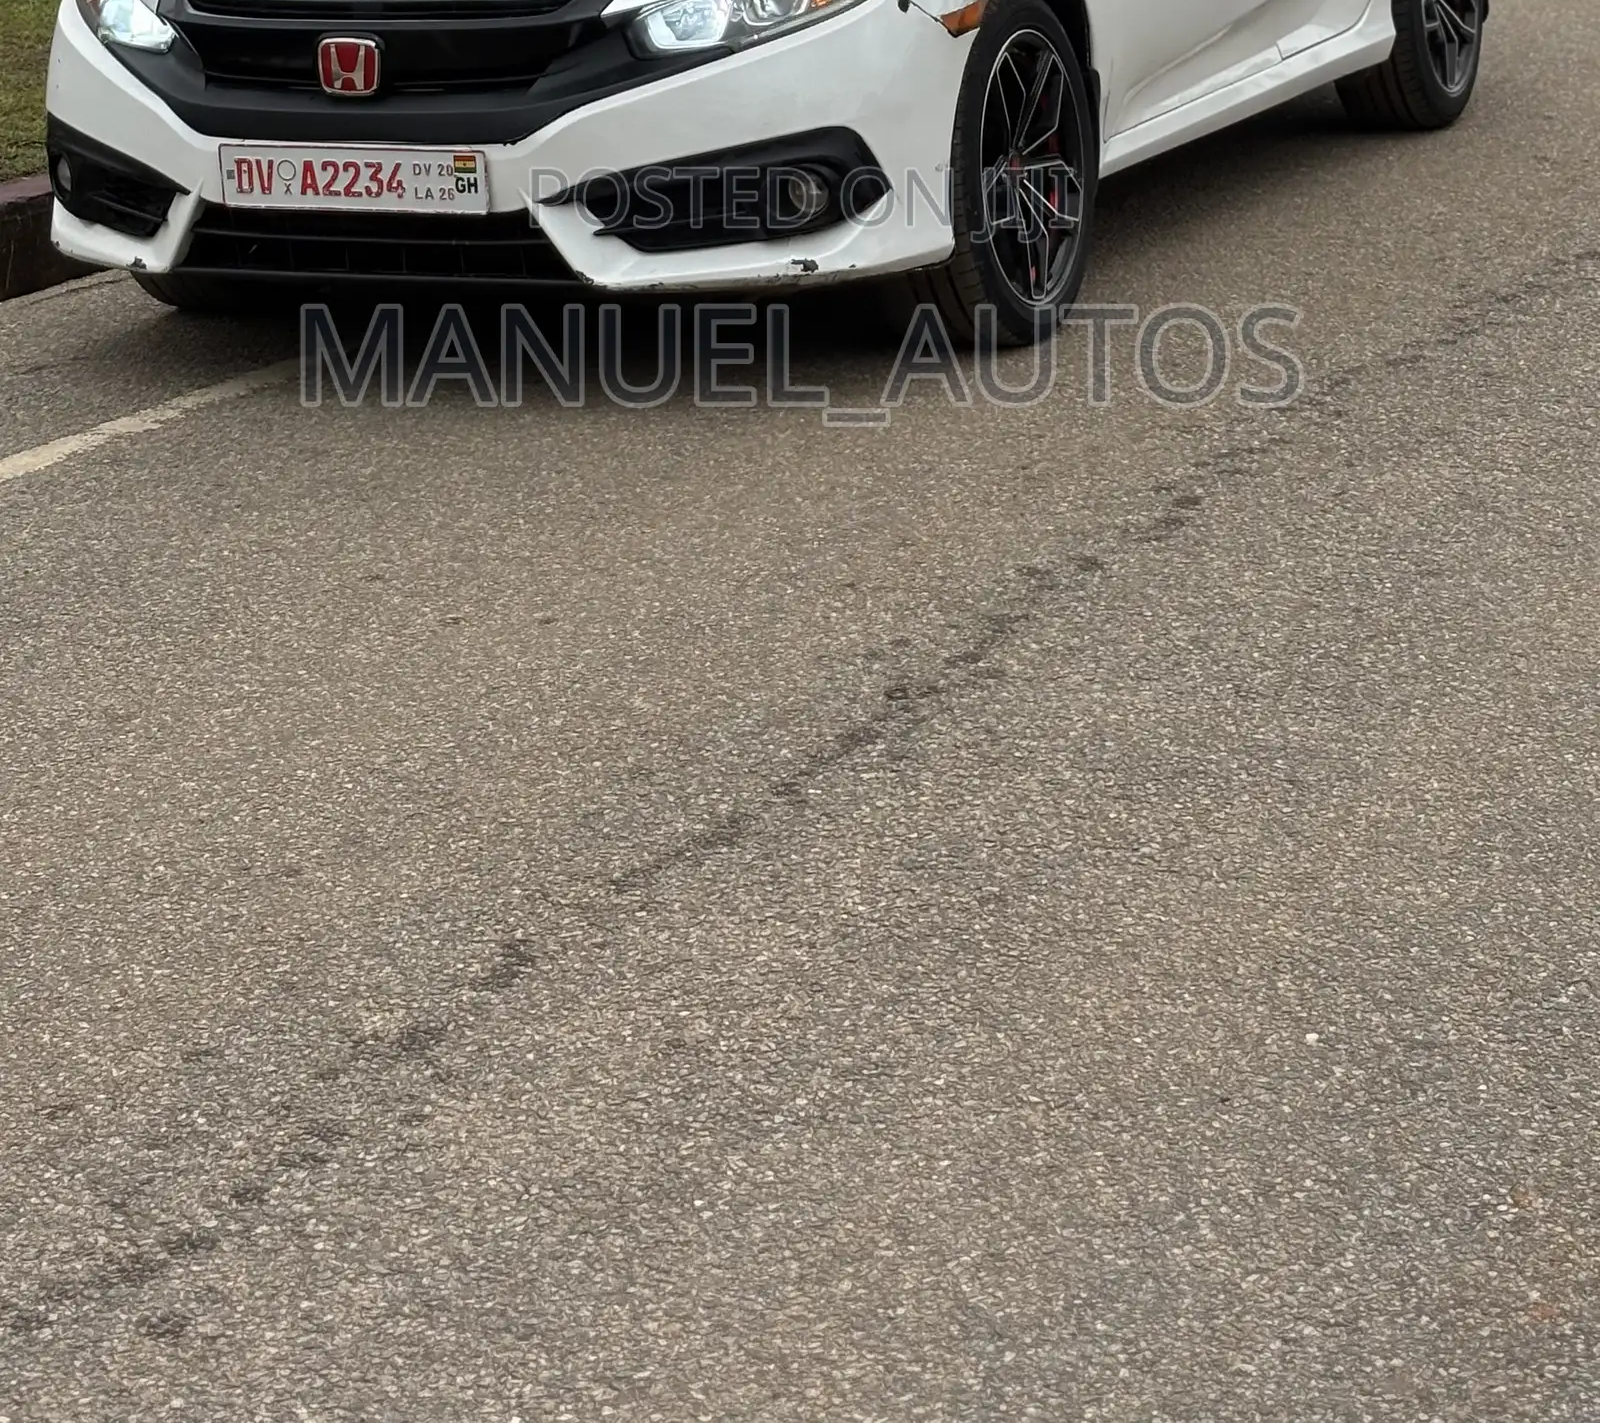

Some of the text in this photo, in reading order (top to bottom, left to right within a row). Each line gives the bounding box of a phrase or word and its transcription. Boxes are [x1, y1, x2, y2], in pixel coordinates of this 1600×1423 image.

[234, 157, 406, 199] DV A2234
[412, 163, 454, 177] DV 20
[455, 176, 478, 194] GH
[414, 186, 455, 201] LA 26
